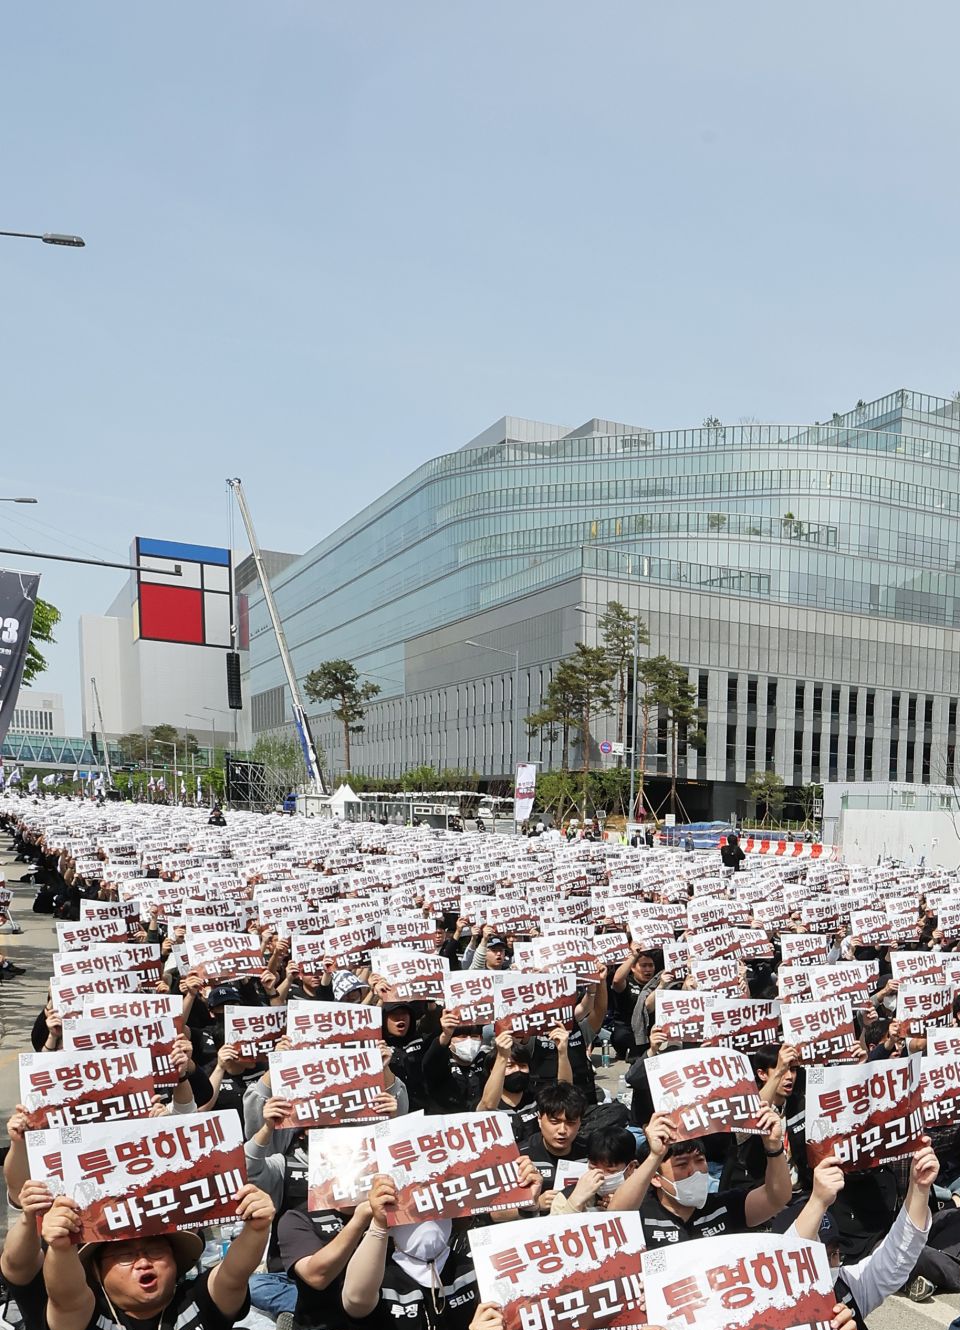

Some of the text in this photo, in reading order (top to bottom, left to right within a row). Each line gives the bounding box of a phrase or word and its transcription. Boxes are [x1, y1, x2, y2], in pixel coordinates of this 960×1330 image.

[158, 885, 200, 899] 투명하게
[428, 884, 461, 898] 투명하게
[85, 904, 135, 918] 투명하게
[491, 904, 526, 918] 투명하게
[558, 901, 589, 915] 투명하게
[632, 905, 665, 919] 투명하게
[691, 908, 725, 924] 투명하게
[757, 904, 786, 917] 투명하게
[286, 915, 330, 932] 투명하게
[386, 921, 430, 936] 투명하게
[855, 914, 887, 929] 투명하게
[63, 922, 119, 944] 투명하게
[329, 926, 377, 949] 투명하게
[693, 931, 735, 955] 투명하게
[193, 936, 252, 956] 투명하게
[539, 939, 593, 958] 투명하게
[785, 937, 822, 952] 투명하게
[205, 956, 261, 975] 바꾸고!!!
[386, 957, 444, 977] 투명하게
[896, 954, 937, 971] 투명하게
[815, 967, 861, 990] 투명하게
[501, 976, 568, 1006] 투명하게
[294, 1009, 372, 1033] 투명하게
[511, 1006, 573, 1033] 바꾸고!!!
[711, 1002, 772, 1028] 투명하게
[789, 1004, 847, 1031] 투명하게
[719, 1028, 776, 1049] 바꾸고!!!
[802, 1033, 853, 1059] 바꾸고!!!
[30, 1052, 138, 1096] 투명하게
[280, 1052, 371, 1089] 투명하게
[659, 1055, 747, 1098] 투명하게
[818, 1059, 914, 1123] 투명하게
[295, 1086, 383, 1122] 바꾸고!!!
[682, 1094, 762, 1131] 바꾸고!!!
[388, 1115, 502, 1171] 투명하게
[833, 1107, 924, 1163] 바꾸고!!!
[77, 1115, 225, 1185] 투명하게
[412, 1161, 519, 1214] 바꾸고!!!
[103, 1169, 244, 1230] 바꾸고!!!
[652, 1230, 679, 1242] 투쟁
[488, 1216, 627, 1285] 투명하게
[662, 1246, 819, 1327] 투명하게
[449, 1290, 474, 1309] SELU
[391, 1304, 418, 1318] 투쟁
